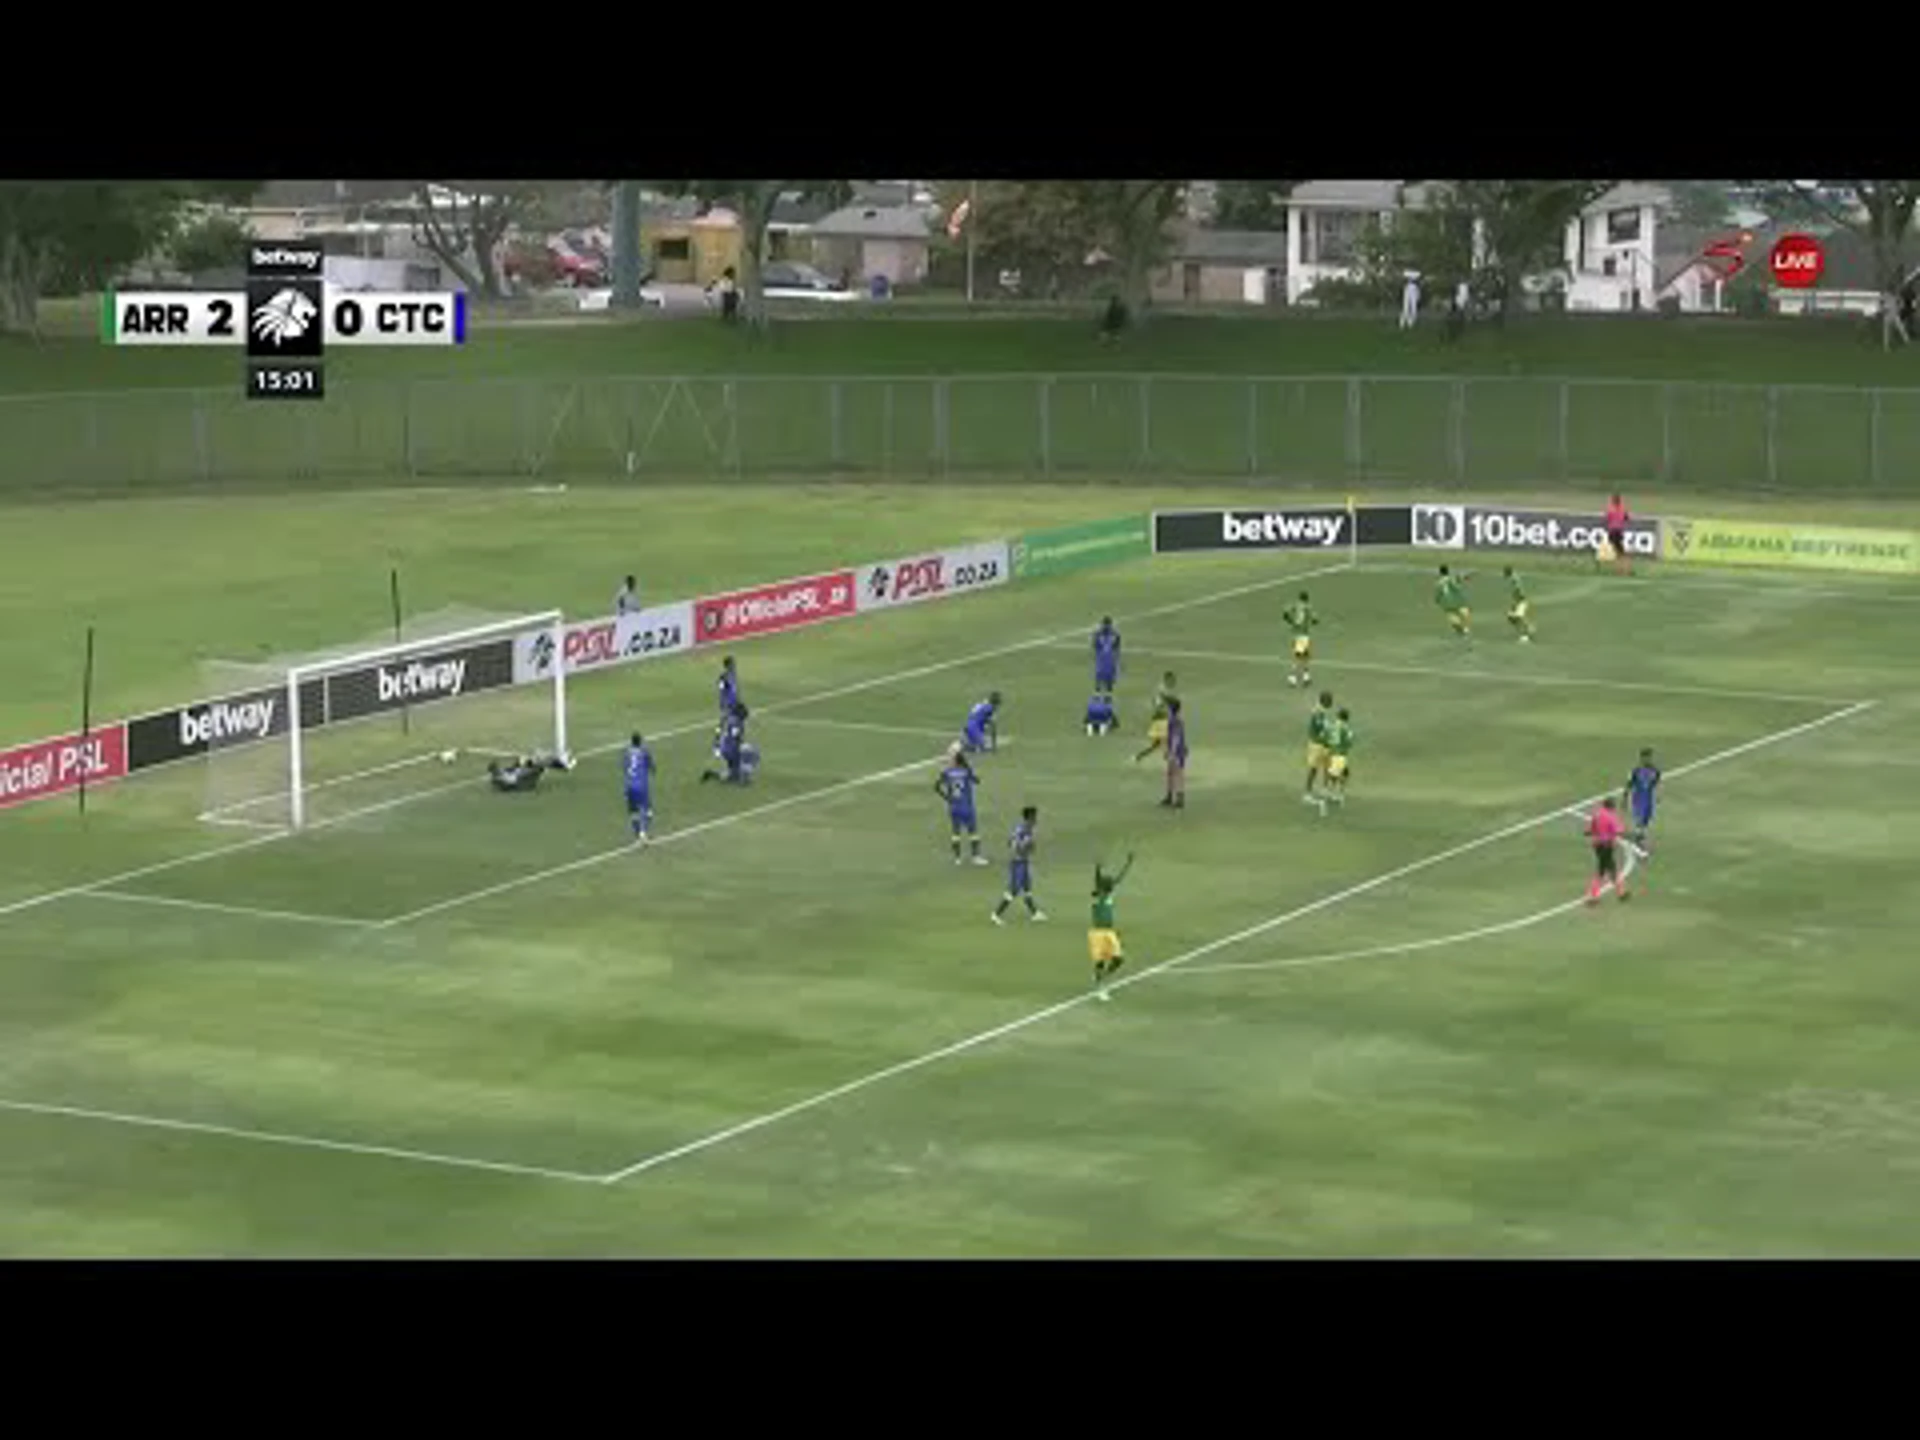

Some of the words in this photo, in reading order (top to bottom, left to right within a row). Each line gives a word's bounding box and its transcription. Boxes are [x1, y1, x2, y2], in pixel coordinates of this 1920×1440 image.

[1223, 512, 1344, 545] betway
[179, 700, 274, 744] betway
[59, 739, 109, 781] PSL
